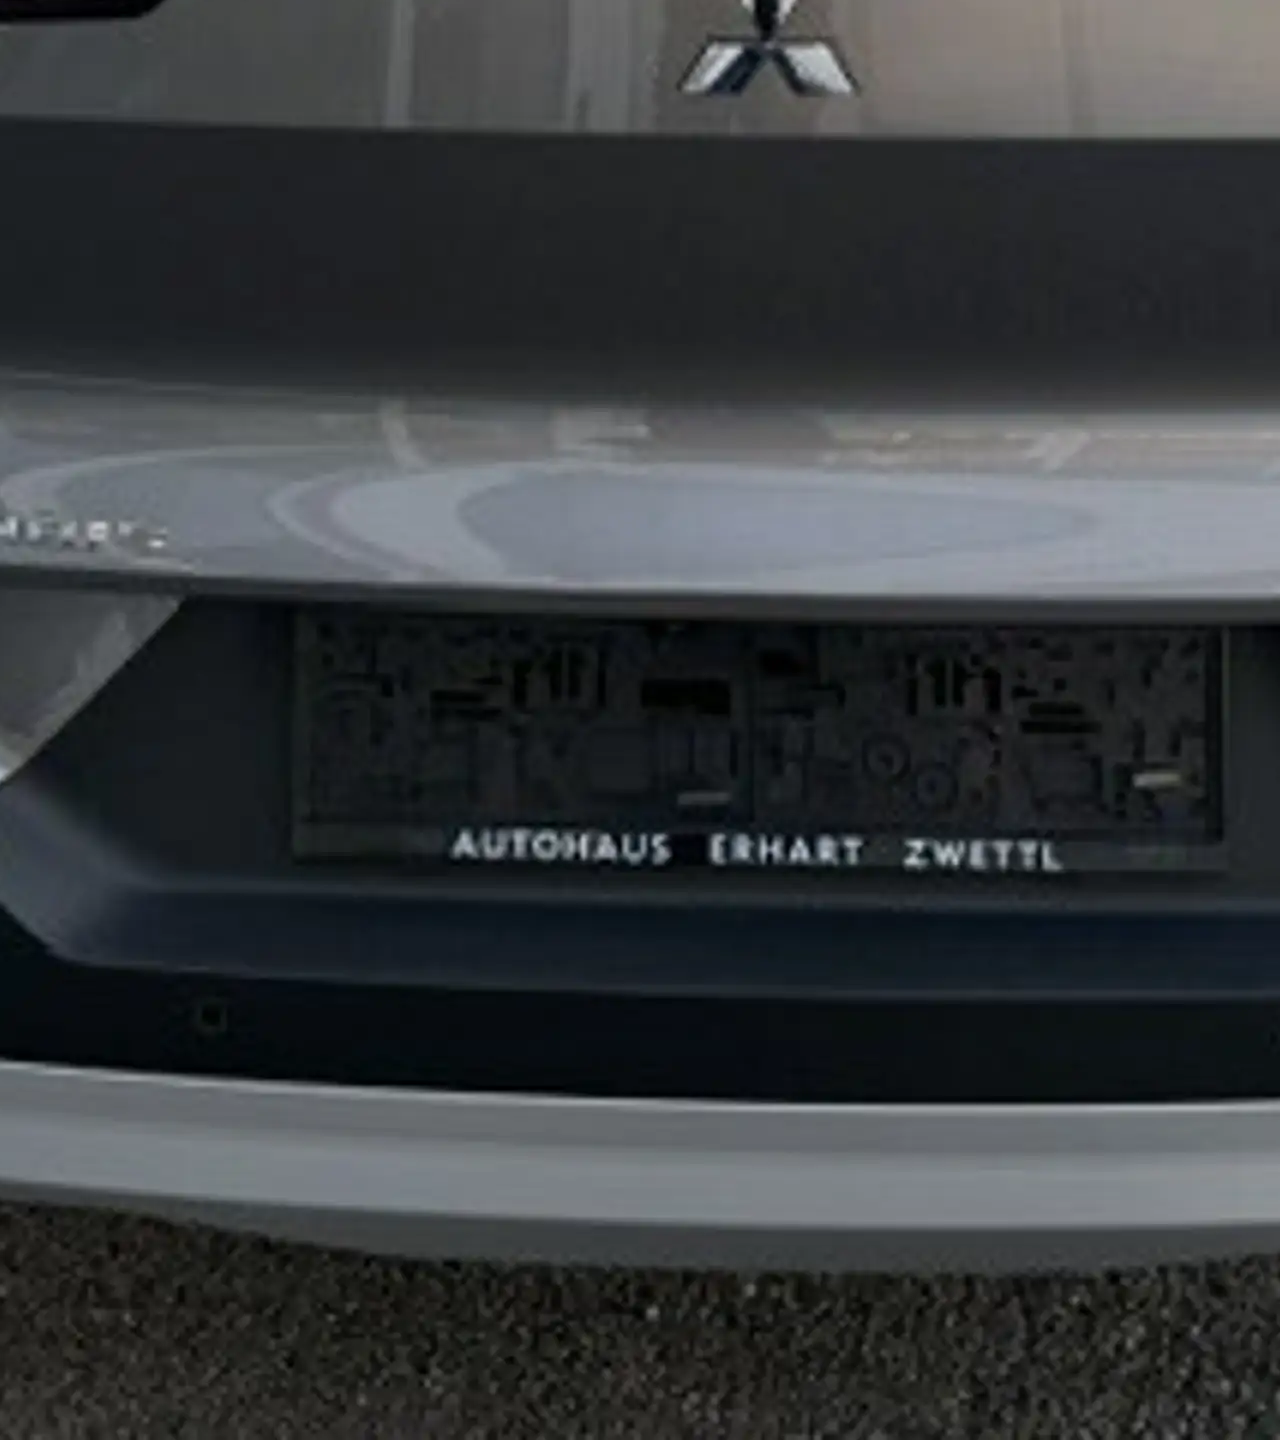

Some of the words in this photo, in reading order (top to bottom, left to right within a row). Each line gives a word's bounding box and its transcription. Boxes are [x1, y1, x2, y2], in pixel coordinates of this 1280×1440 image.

[451, 827, 672, 865] AUTOHAUS
[709, 832, 865, 869] ERHART
[904, 840, 1064, 873] ZWETTL
